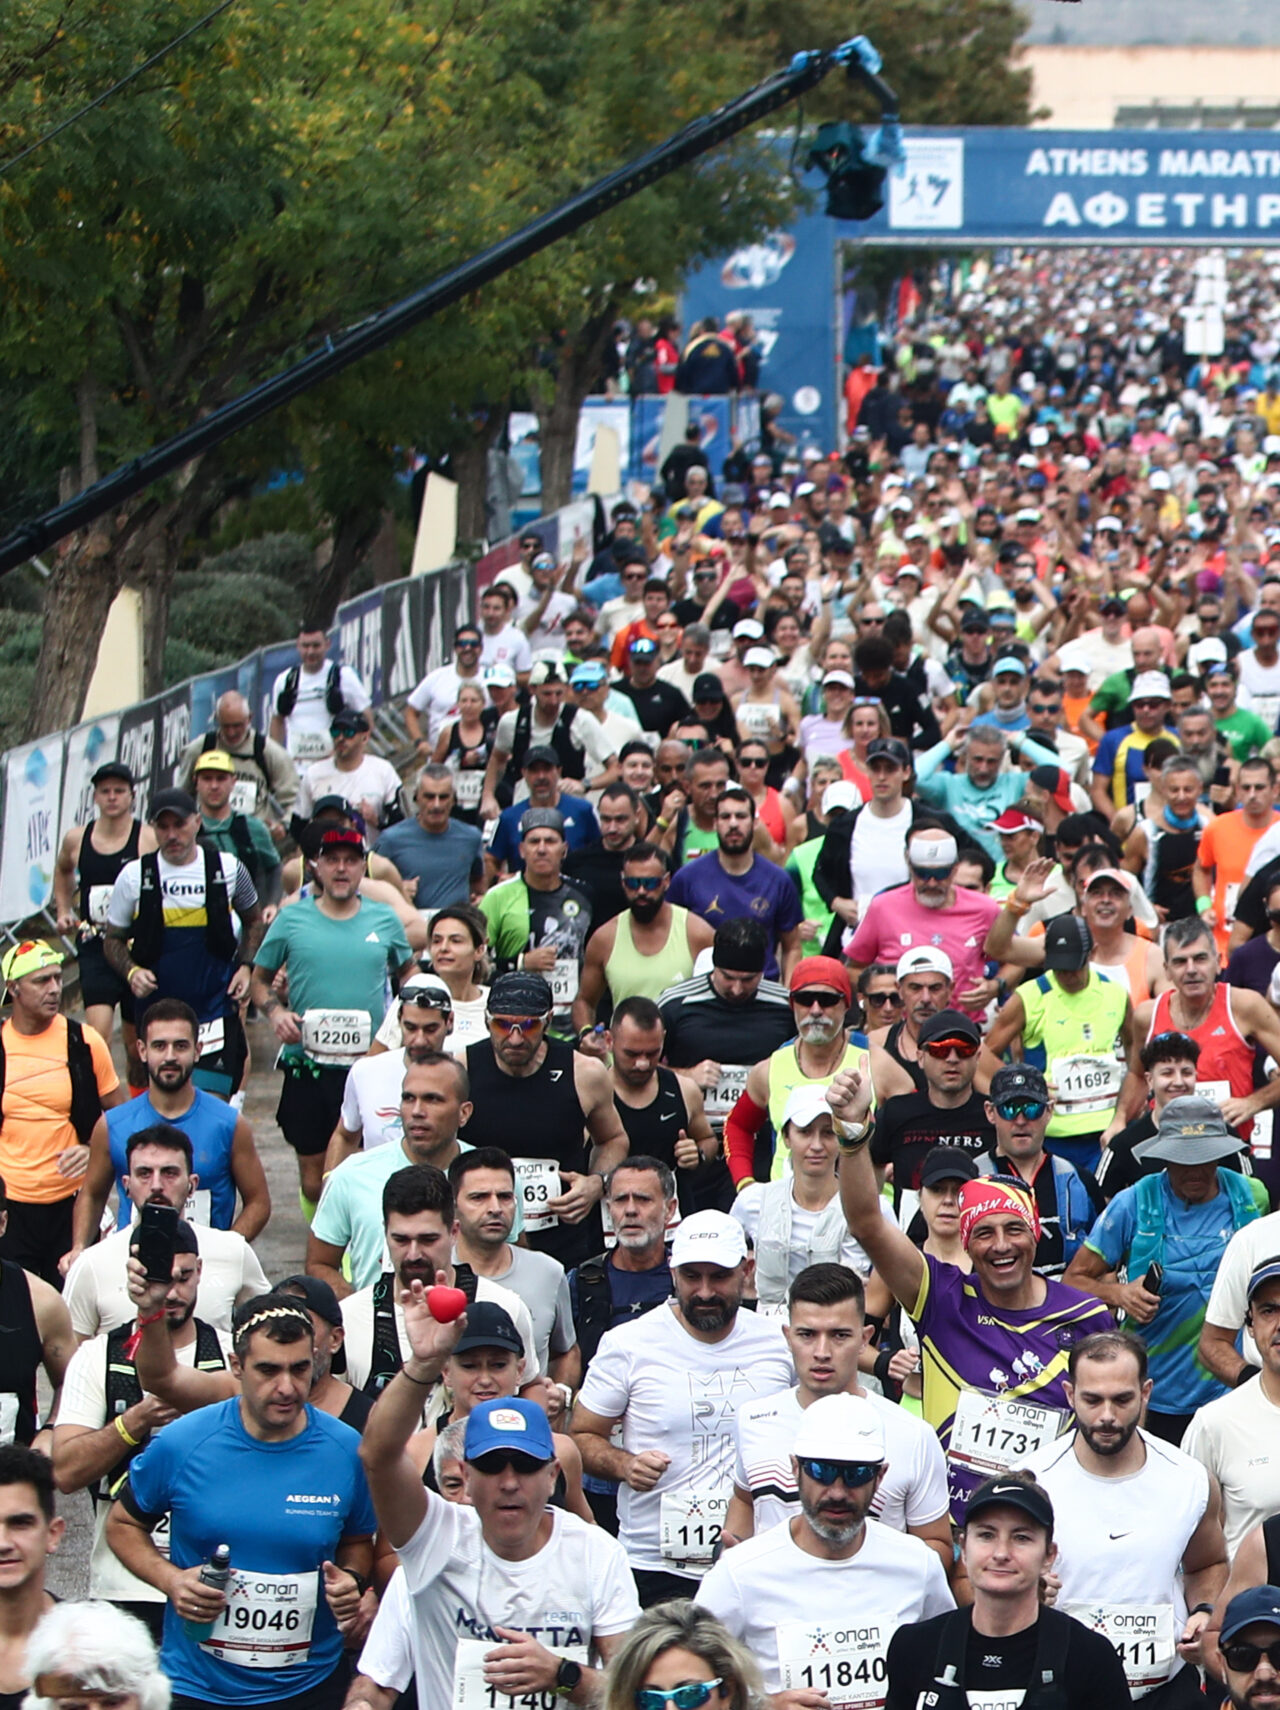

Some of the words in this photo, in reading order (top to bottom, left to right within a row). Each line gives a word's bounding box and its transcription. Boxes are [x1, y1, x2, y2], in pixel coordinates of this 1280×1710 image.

[1025, 149, 1149, 177] ATHENS
[312, 1030, 361, 1045] 12206
[1064, 1071, 1111, 1091] 11692
[971, 1422, 1041, 1455] 11731
[286, 1494, 332, 1504] AEGEAN
[223, 1605, 300, 1631] 19046
[543, 1610, 583, 1623] team
[800, 1656, 888, 1690] 11840
